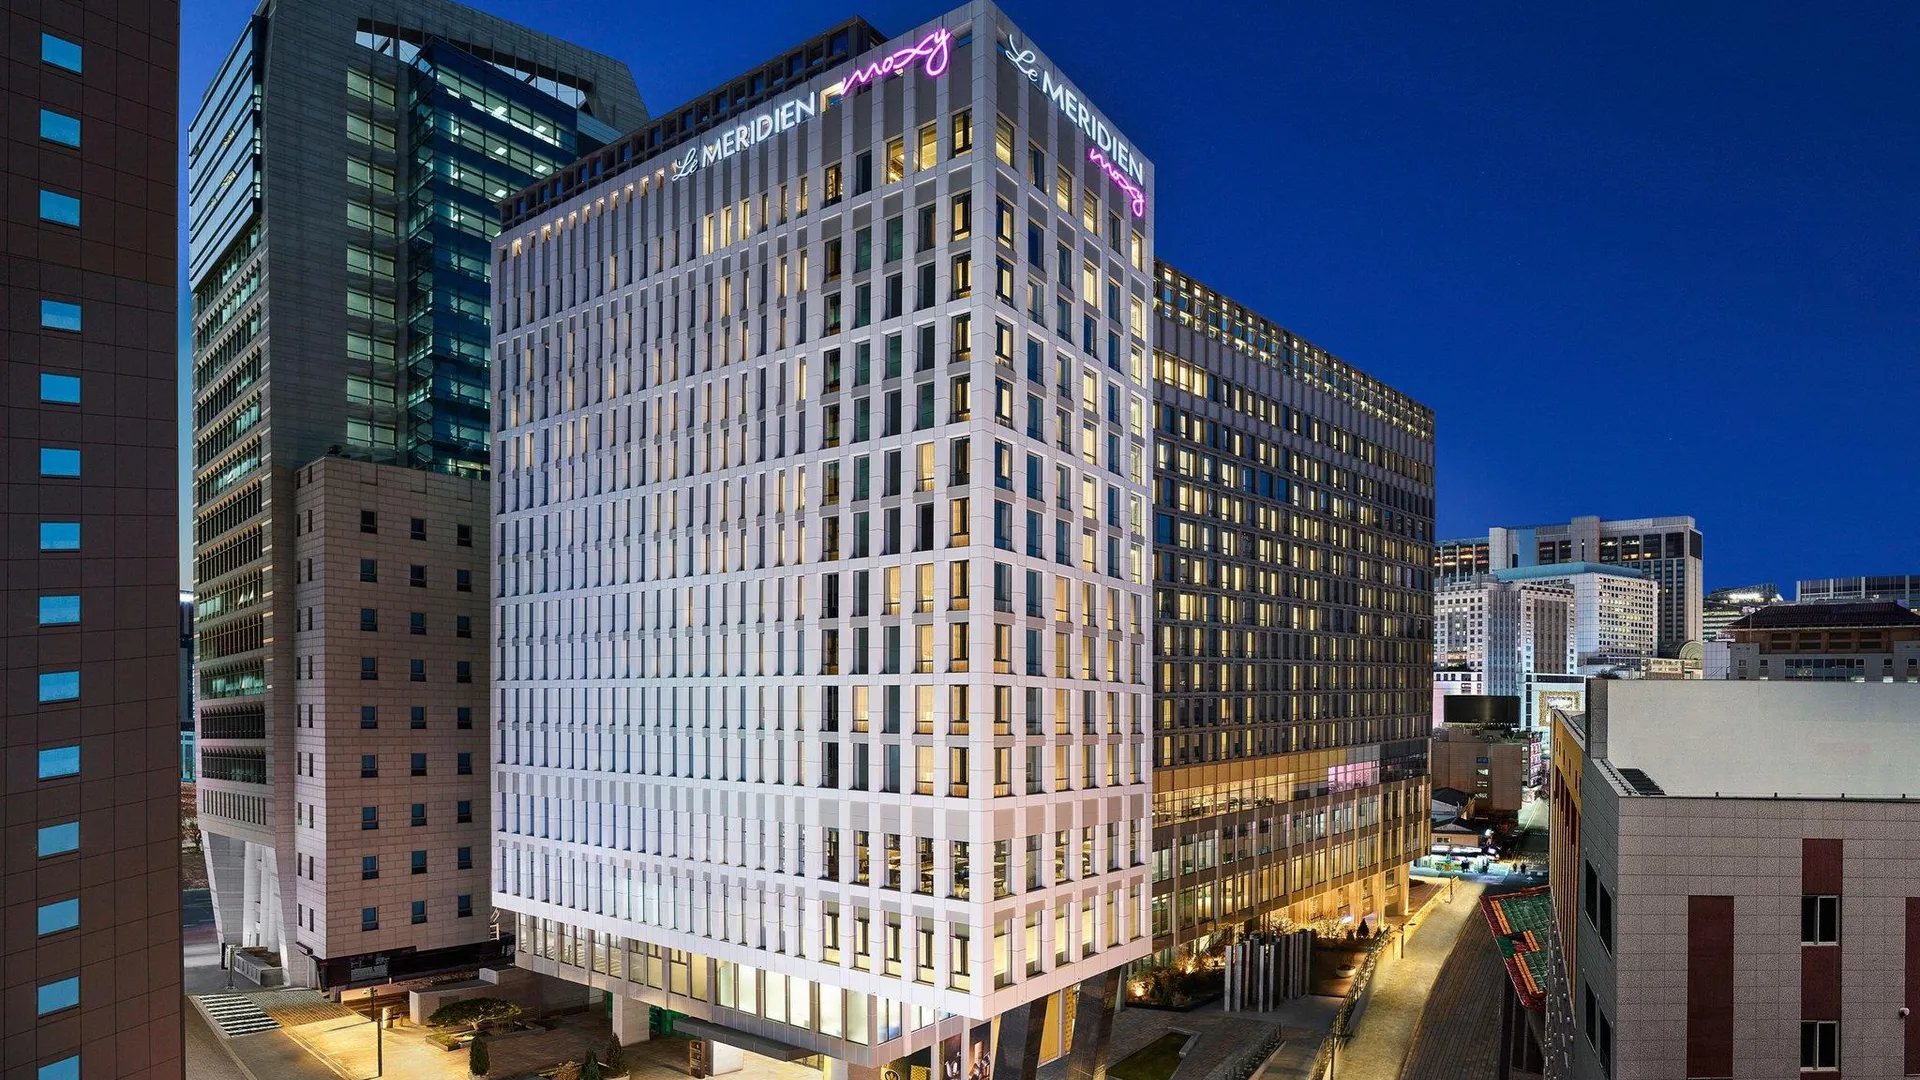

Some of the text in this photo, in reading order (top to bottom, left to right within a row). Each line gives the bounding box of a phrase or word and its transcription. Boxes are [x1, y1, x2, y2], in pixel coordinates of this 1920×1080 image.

[840, 28, 951, 95] moxy
[671, 91, 815, 182] Le MERIDIEN
[1005, 34, 1143, 186] Le MERIDIEN
[1089, 147, 1145, 217] moxy
